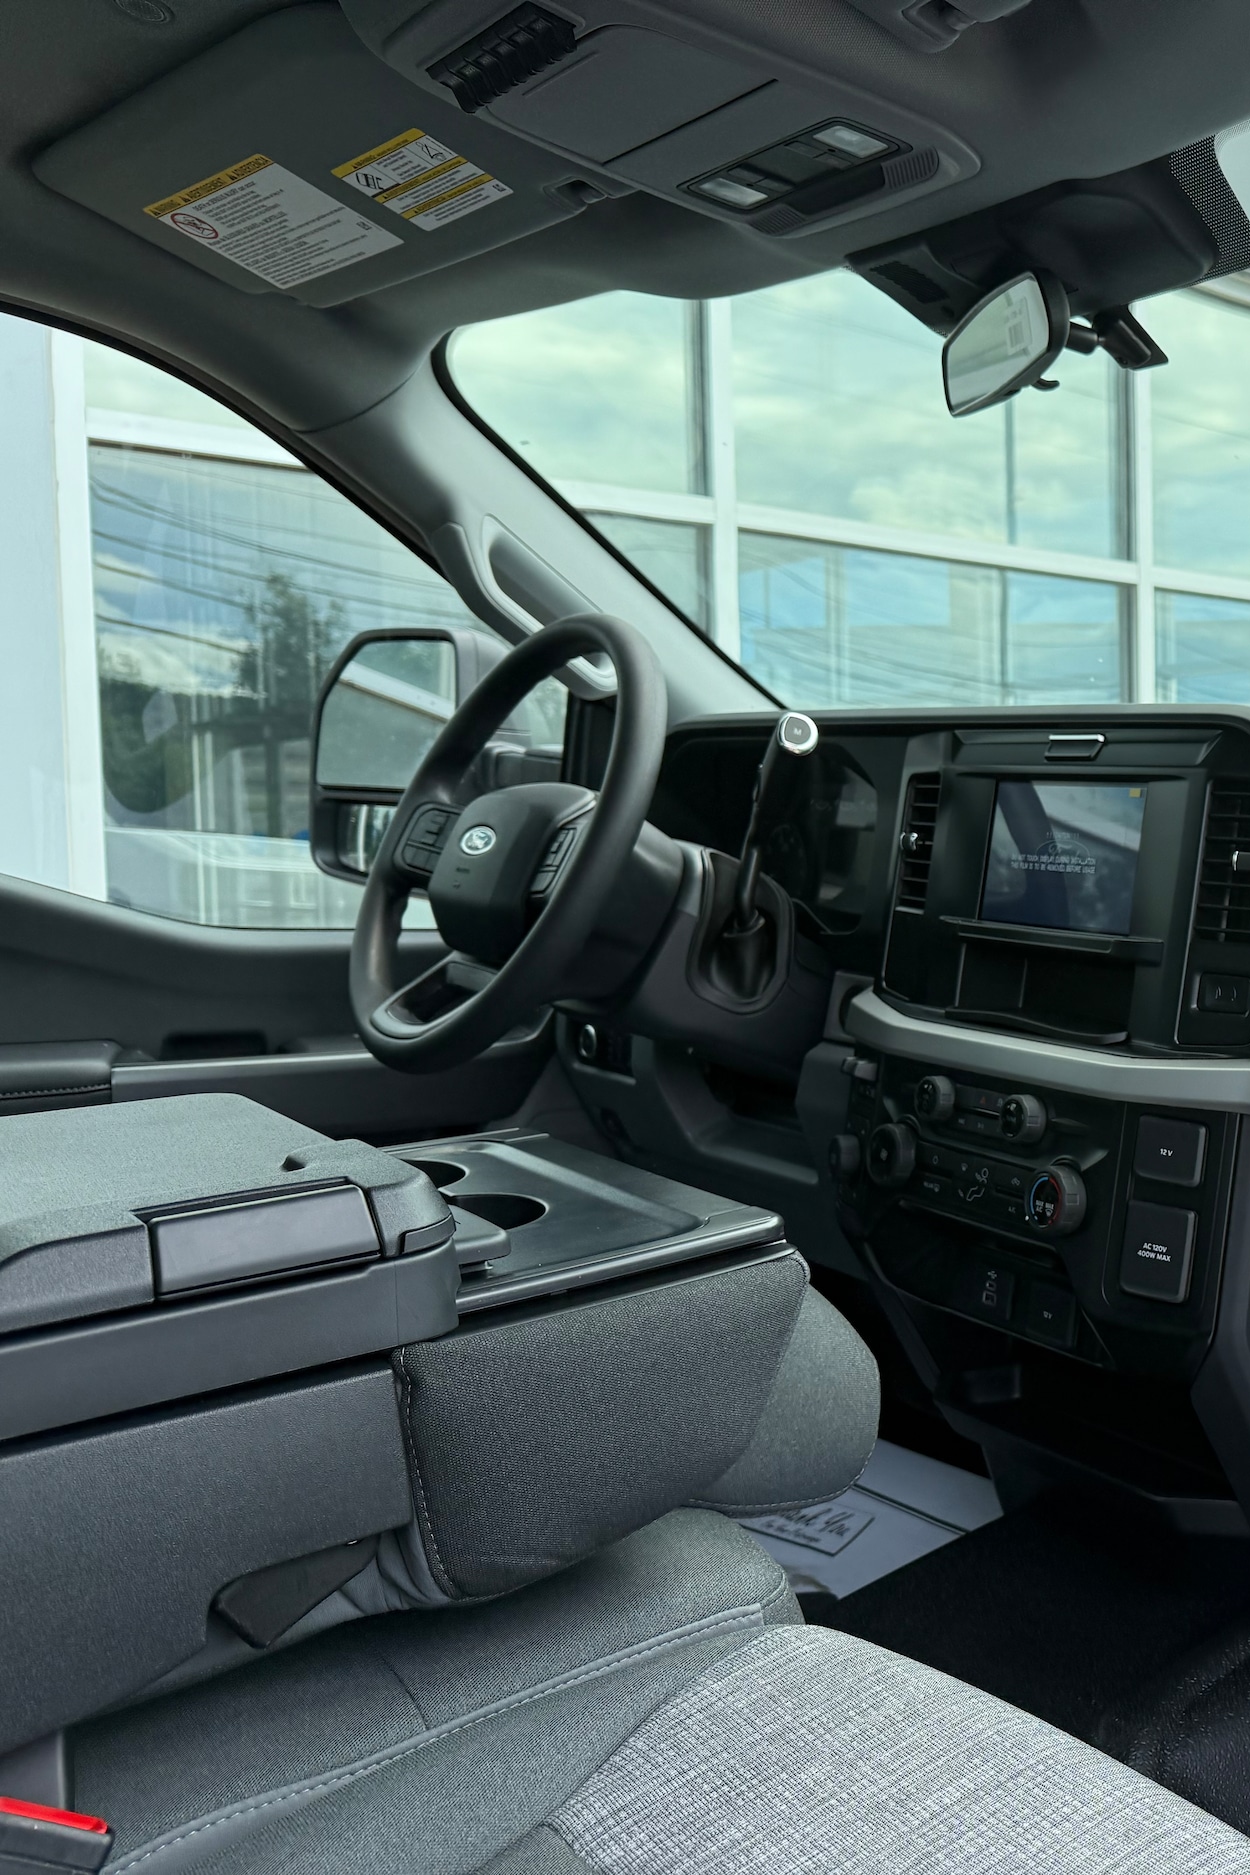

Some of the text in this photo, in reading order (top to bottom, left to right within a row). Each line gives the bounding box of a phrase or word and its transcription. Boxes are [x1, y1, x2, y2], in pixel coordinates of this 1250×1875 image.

[1142, 1241, 1168, 1254] AC 120V
[1137, 1250, 1172, 1262] 400W MAX
